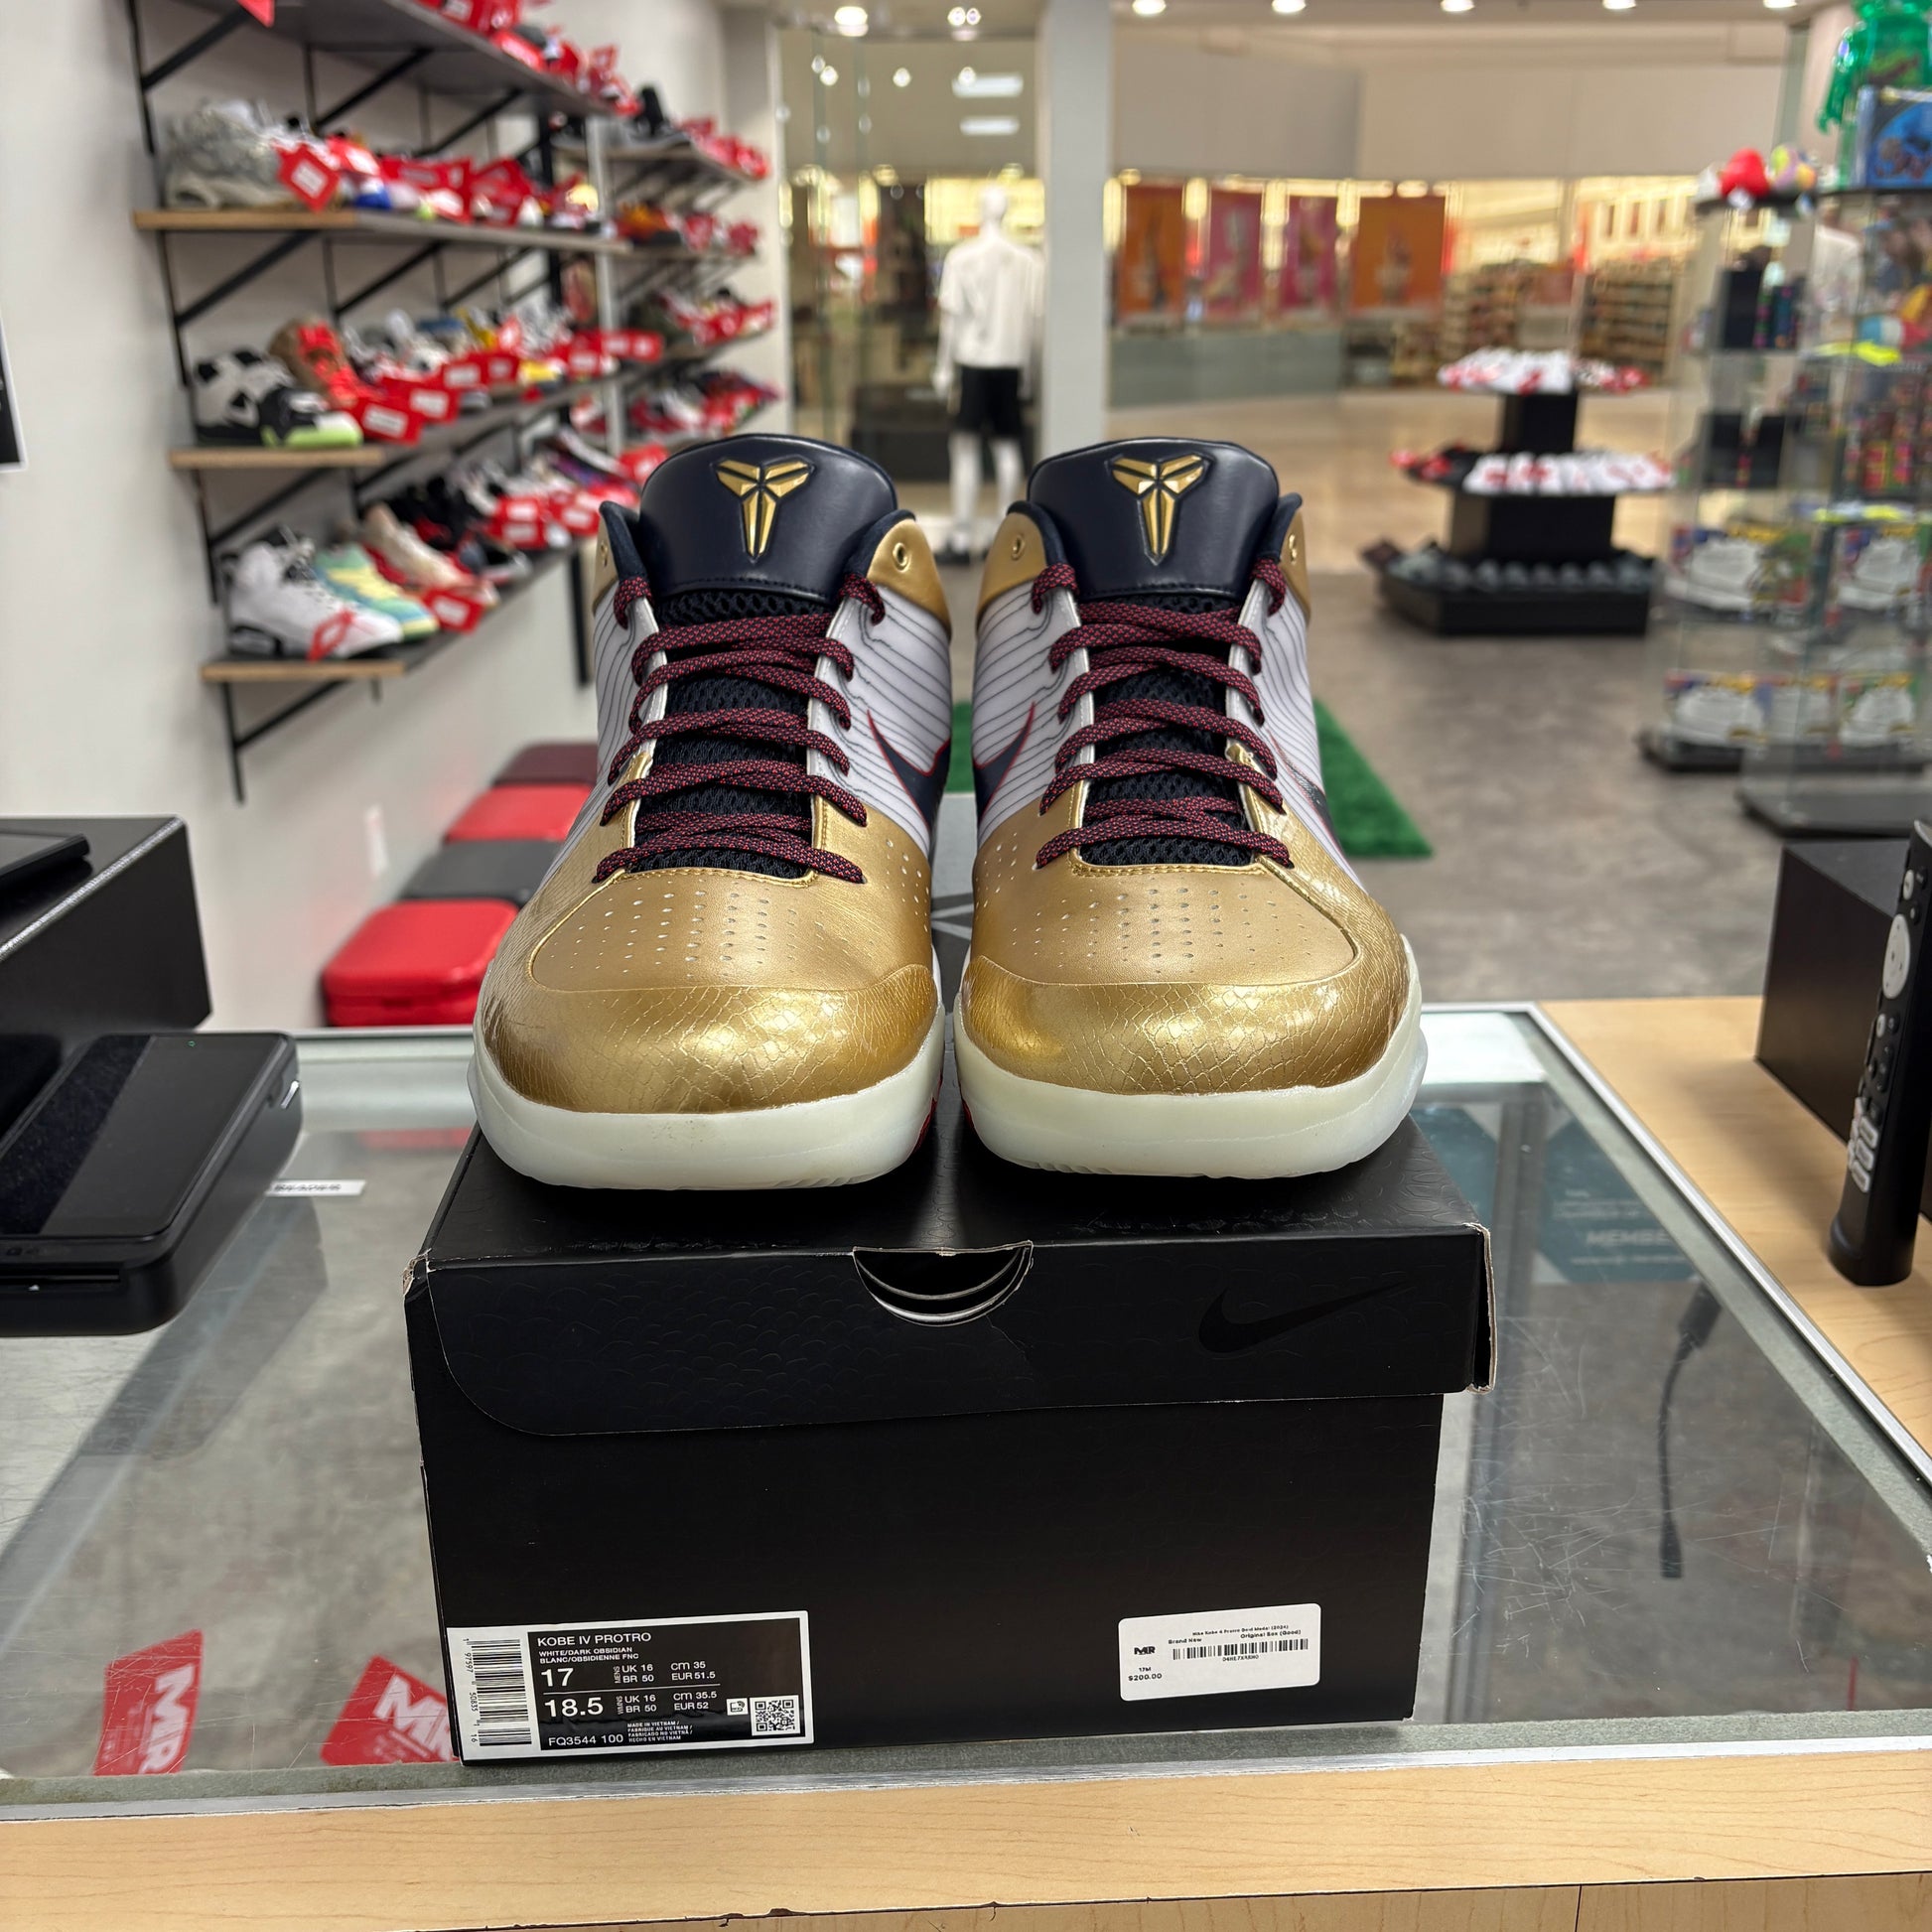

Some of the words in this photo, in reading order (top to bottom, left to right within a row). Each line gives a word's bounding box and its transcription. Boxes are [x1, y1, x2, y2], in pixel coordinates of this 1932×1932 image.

[537, 1636, 575, 1647] KOBE
[579, 1635, 591, 1645] IV
[595, 1632, 651, 1644] PROTRO
[538, 1648, 592, 1657] WHITE/DARK
[593, 1646, 632, 1655] OBSIDIAN
[539, 1654, 621, 1664] BLANC/OBSIDIENNE
[640, 1663, 653, 1672] 16
[693, 1660, 706, 1669] 35
[541, 1668, 574, 1687] 17
[622, 1675, 638, 1684] BR
[671, 1672, 693, 1681] EUR
[694, 1671, 716, 1680] 51.5
[1128, 1673, 1163, 1682] $200.00
[624, 1695, 640, 1704] UK
[544, 1697, 604, 1718] 18.5
[625, 1705, 640, 1714] BR
[674, 1702, 695, 1711] EUR
[548, 1735, 597, 1746] FQ3544
[601, 1733, 623, 1743] 100
